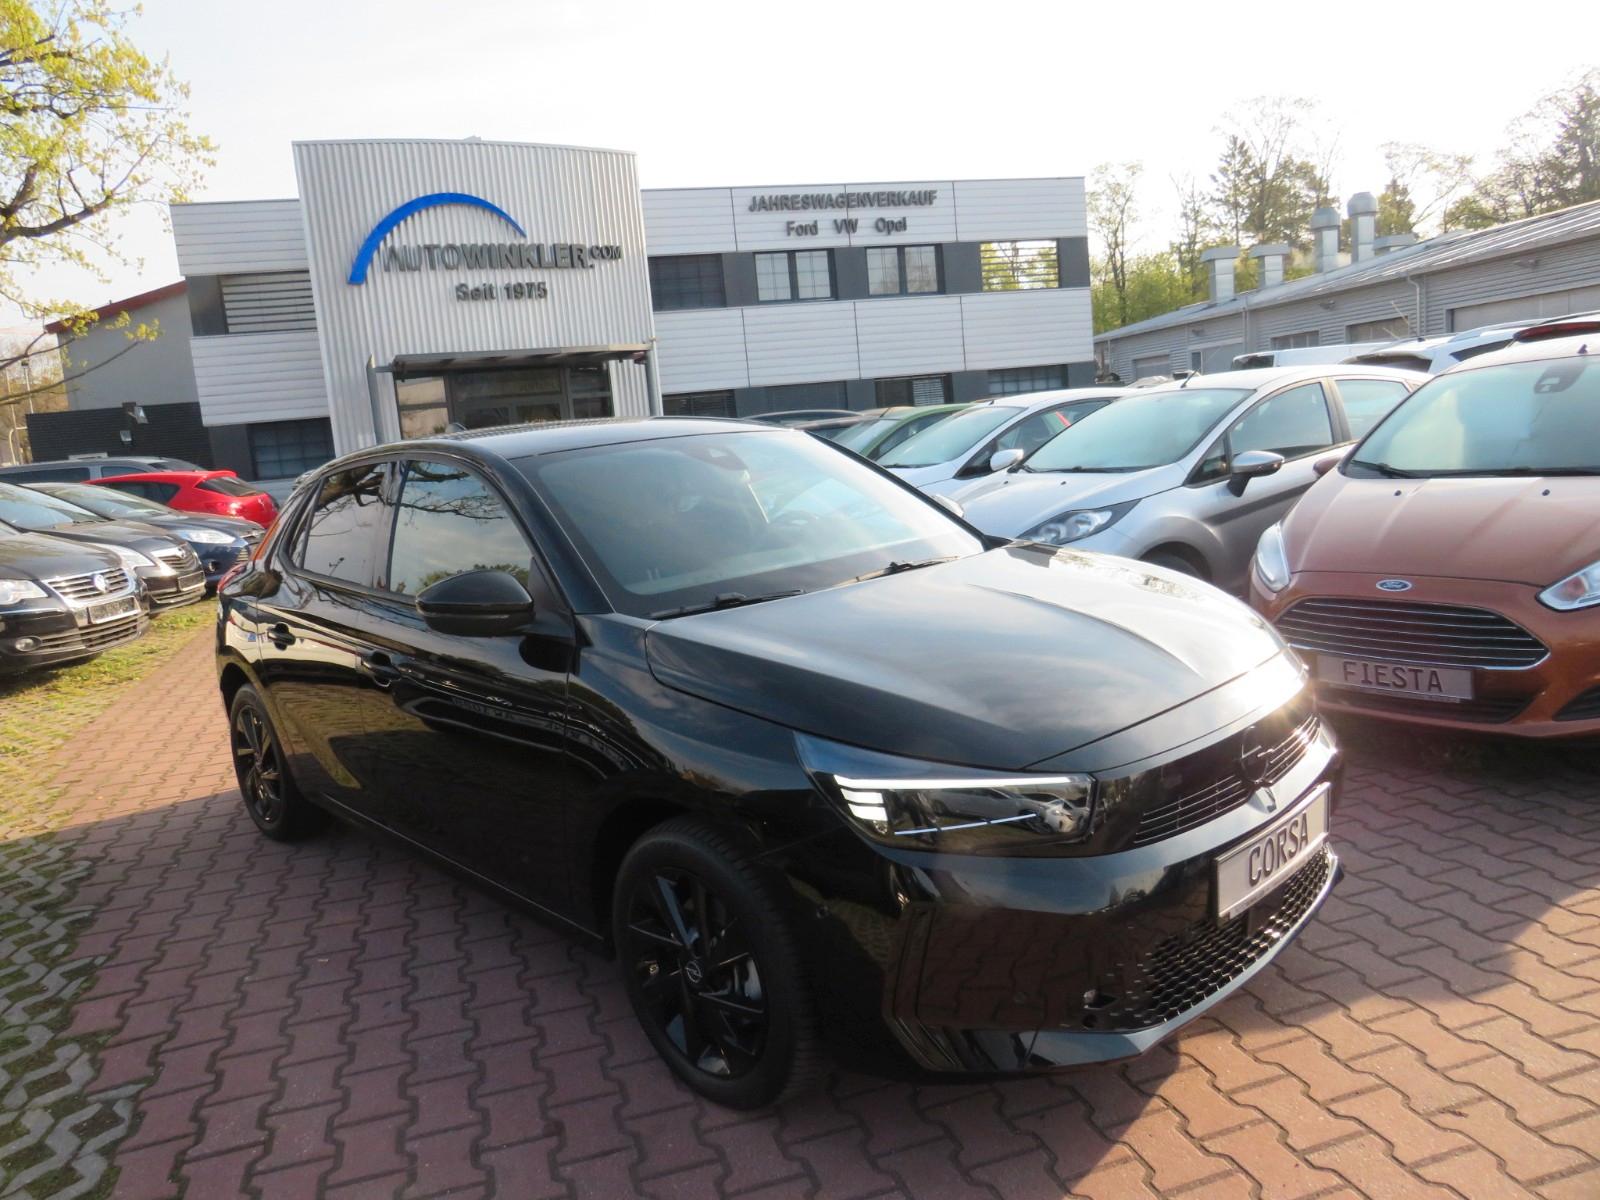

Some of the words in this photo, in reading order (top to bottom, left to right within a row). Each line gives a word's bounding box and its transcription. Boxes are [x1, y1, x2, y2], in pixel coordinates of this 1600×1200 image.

[748, 190, 938, 212] JAHRESWAGENVERKAUF
[786, 220, 818, 236] Ford
[833, 218, 858, 234] VW
[875, 216, 907, 235] Opel
[455, 282, 496, 301] Seit
[504, 281, 548, 300] 1975
[1343, 661, 1442, 692] FIESTA
[1249, 812, 1309, 887] CORSA
